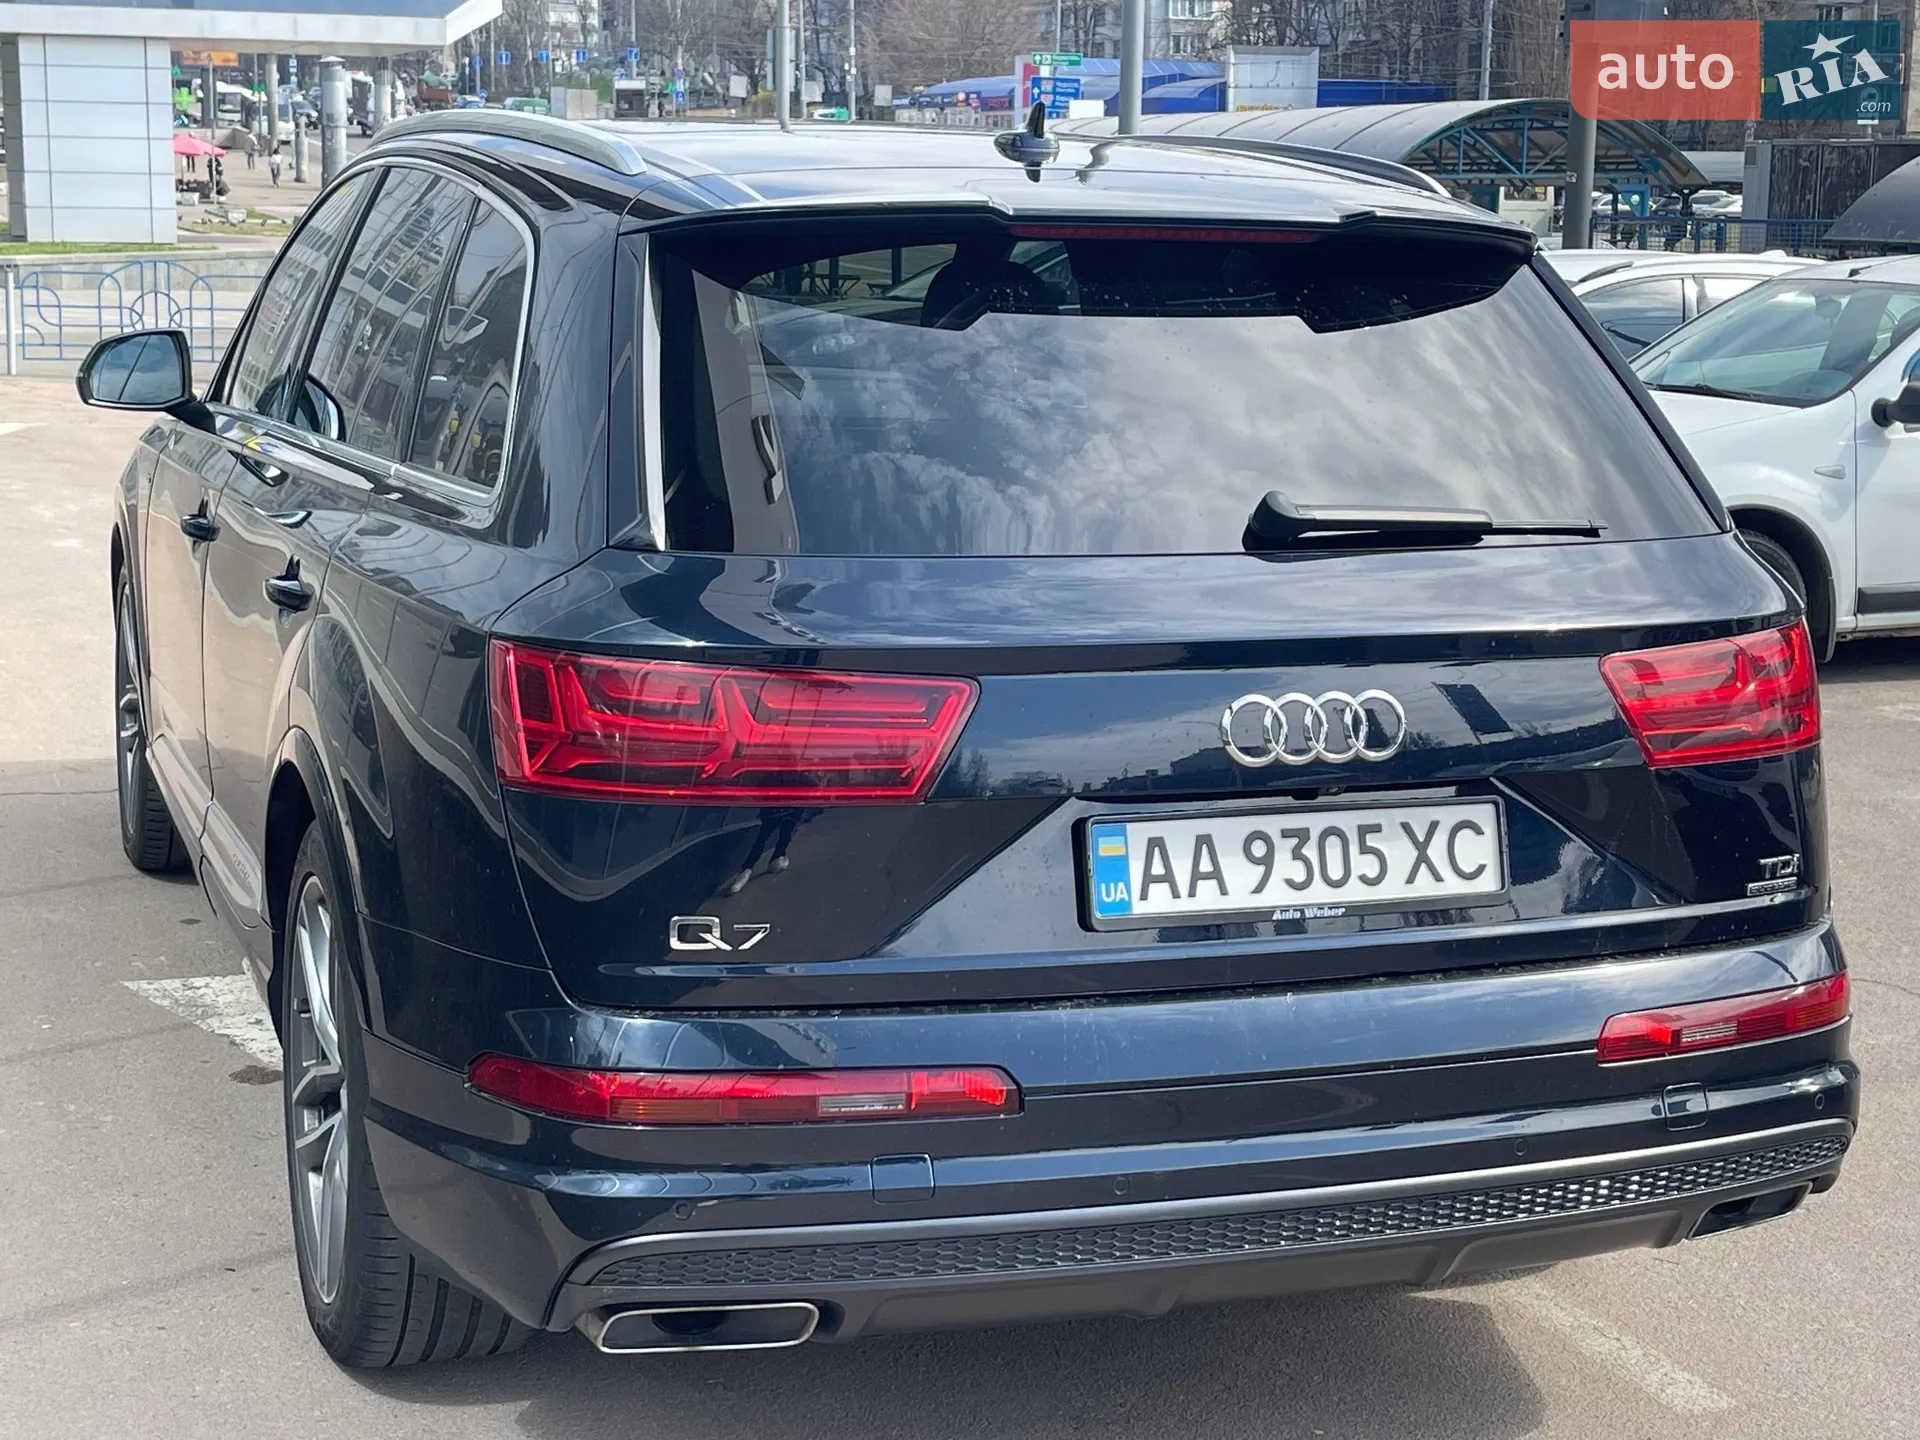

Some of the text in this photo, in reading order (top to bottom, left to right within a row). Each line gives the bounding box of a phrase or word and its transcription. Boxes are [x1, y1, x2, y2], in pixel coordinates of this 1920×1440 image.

[1139, 819, 1488, 901] AA 9305 XC
[1101, 881, 1130, 902] UA
[1272, 906, 1346, 920] Auto Weber
[669, 915, 771, 951] Q7
